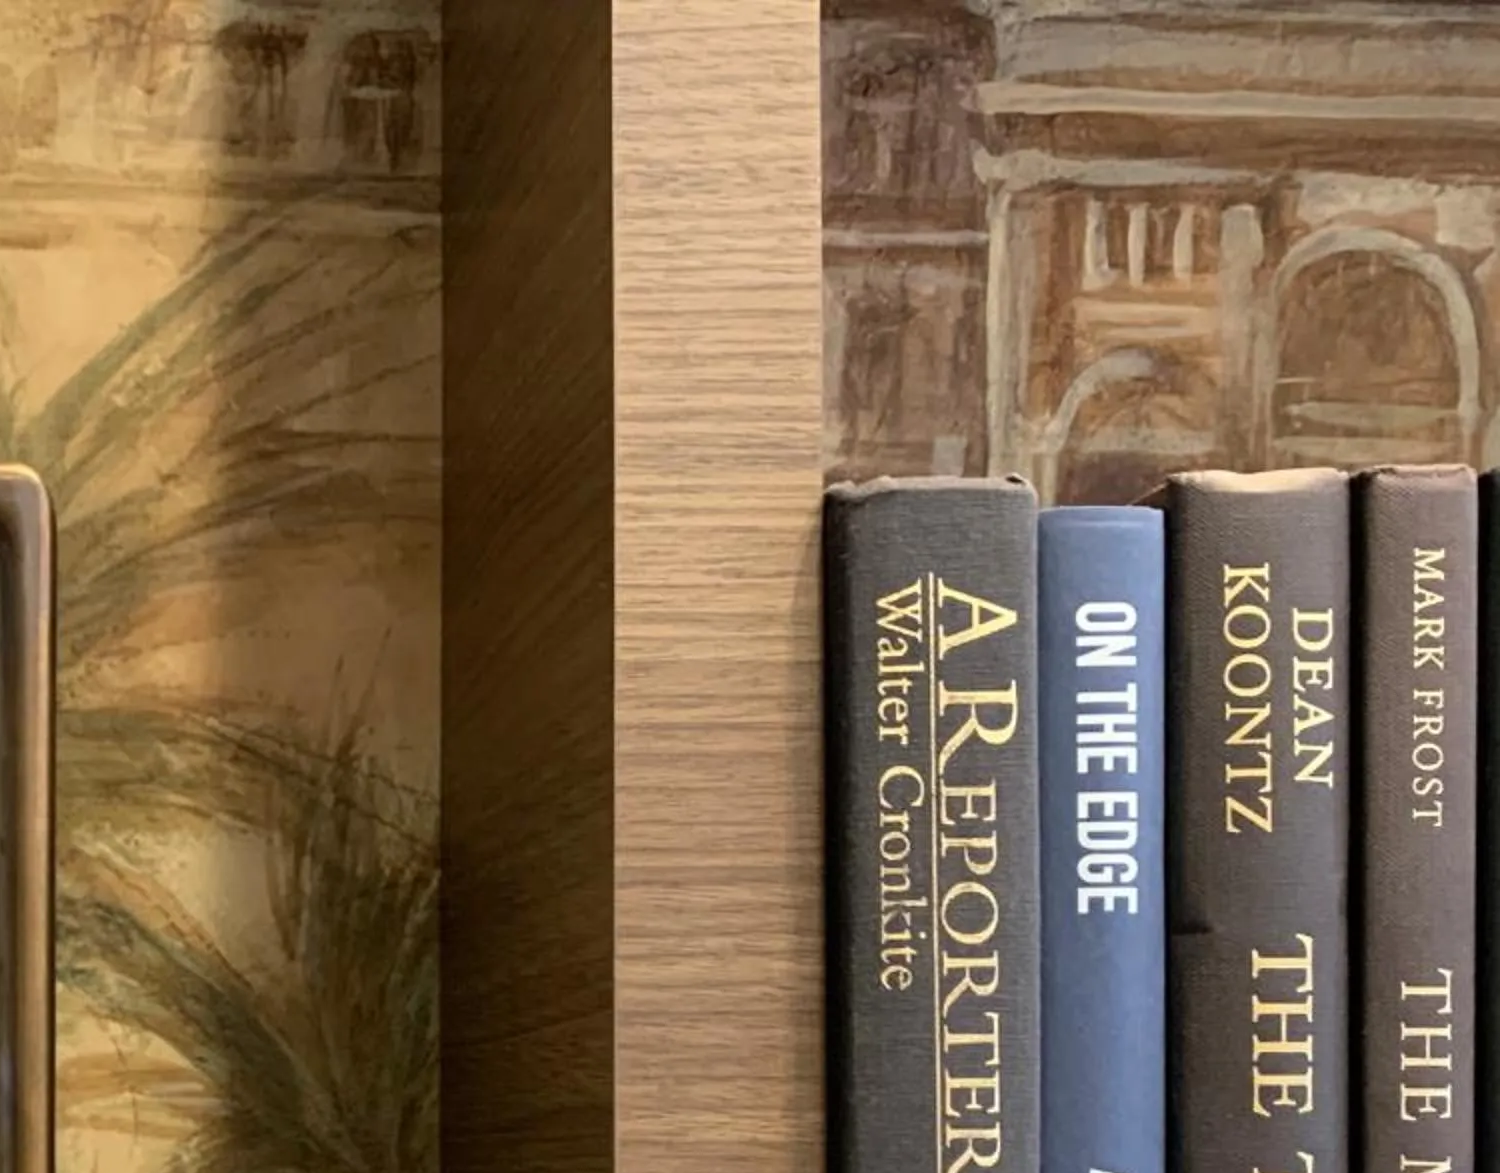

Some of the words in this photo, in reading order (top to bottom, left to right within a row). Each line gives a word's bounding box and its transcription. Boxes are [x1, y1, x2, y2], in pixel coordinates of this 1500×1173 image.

[875, 578, 922, 743] Walter
[935, 577, 1018, 660] A
[1075, 601, 1138, 667] ON
[1412, 547, 1447, 670] MARK
[1076, 683, 1138, 775] THE
[1222, 563, 1274, 834] KOONTZ
[1291, 608, 1334, 789] DEAN
[1411, 688, 1446, 828] FROST
[877, 766, 928, 992] Cronkite
[1077, 791, 1139, 915] EDGE
[1251, 933, 1315, 1118] THE
[1399, 967, 1454, 1122] THE
